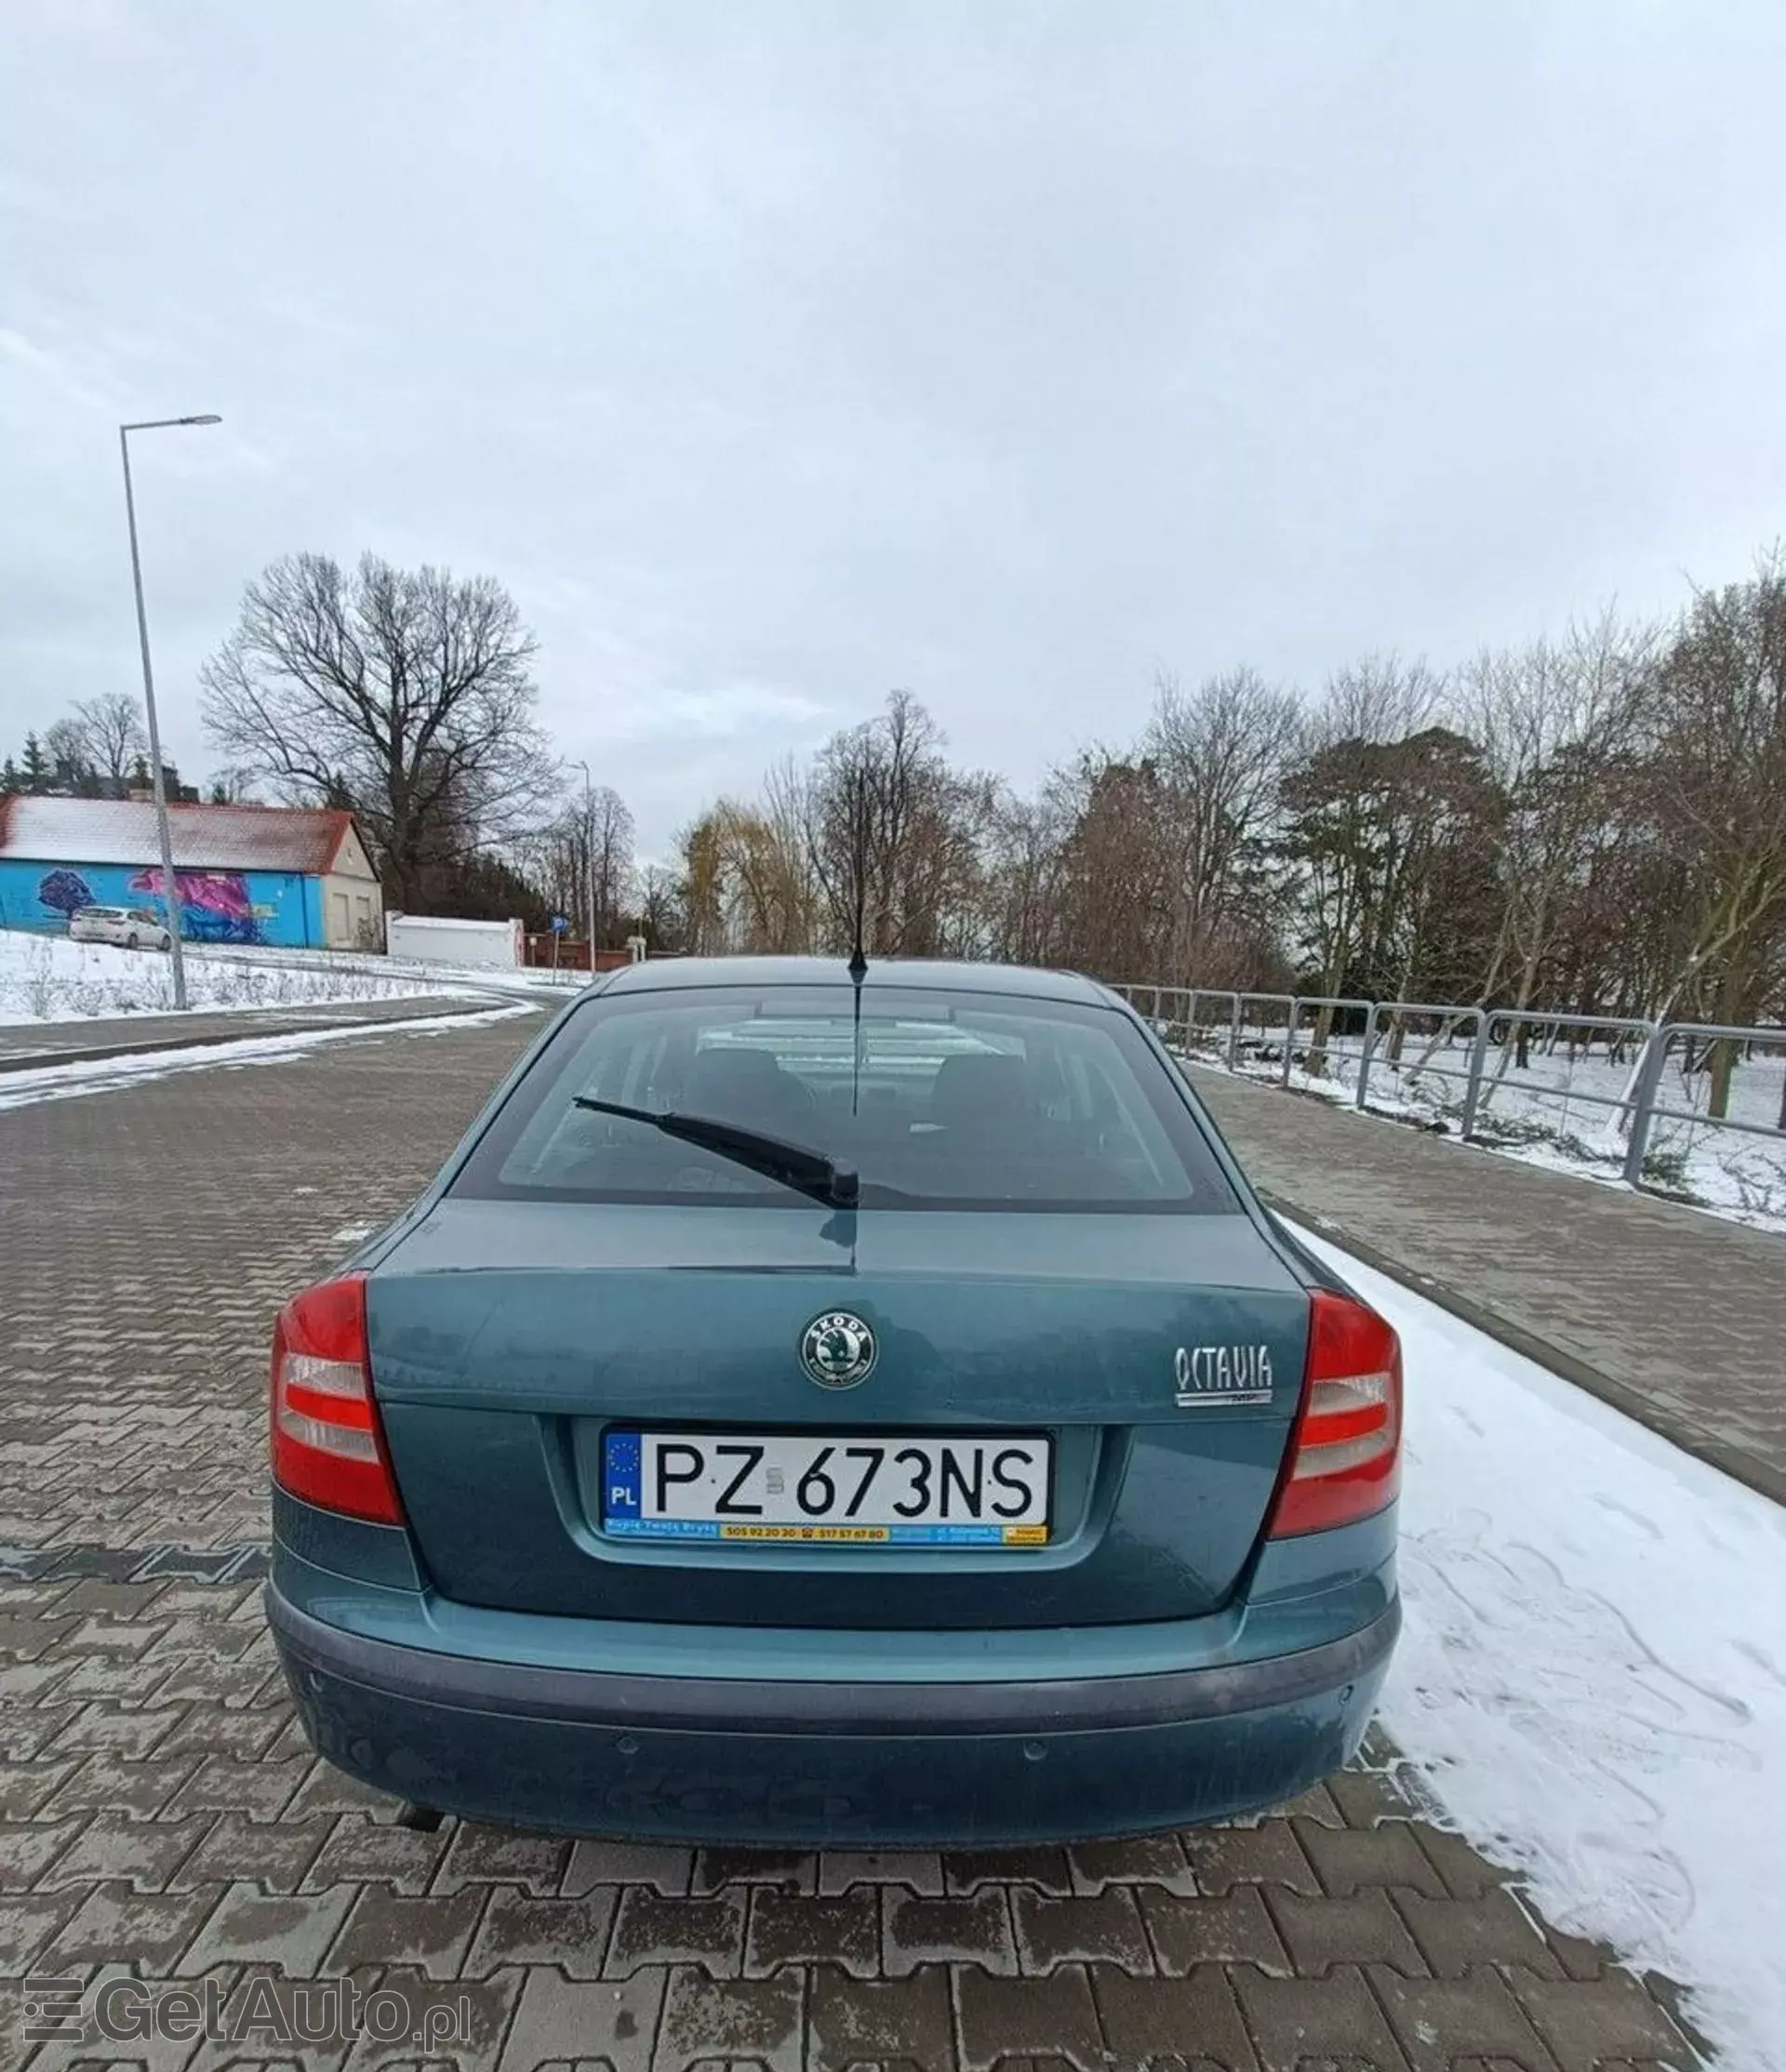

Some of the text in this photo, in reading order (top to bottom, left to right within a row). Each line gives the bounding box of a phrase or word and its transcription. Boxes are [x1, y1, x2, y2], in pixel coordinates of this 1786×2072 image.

[1175, 1345, 1273, 1390] OCTAVIA
[611, 1486, 637, 1506] PL
[656, 1443, 1034, 1518] PZ 673NS
